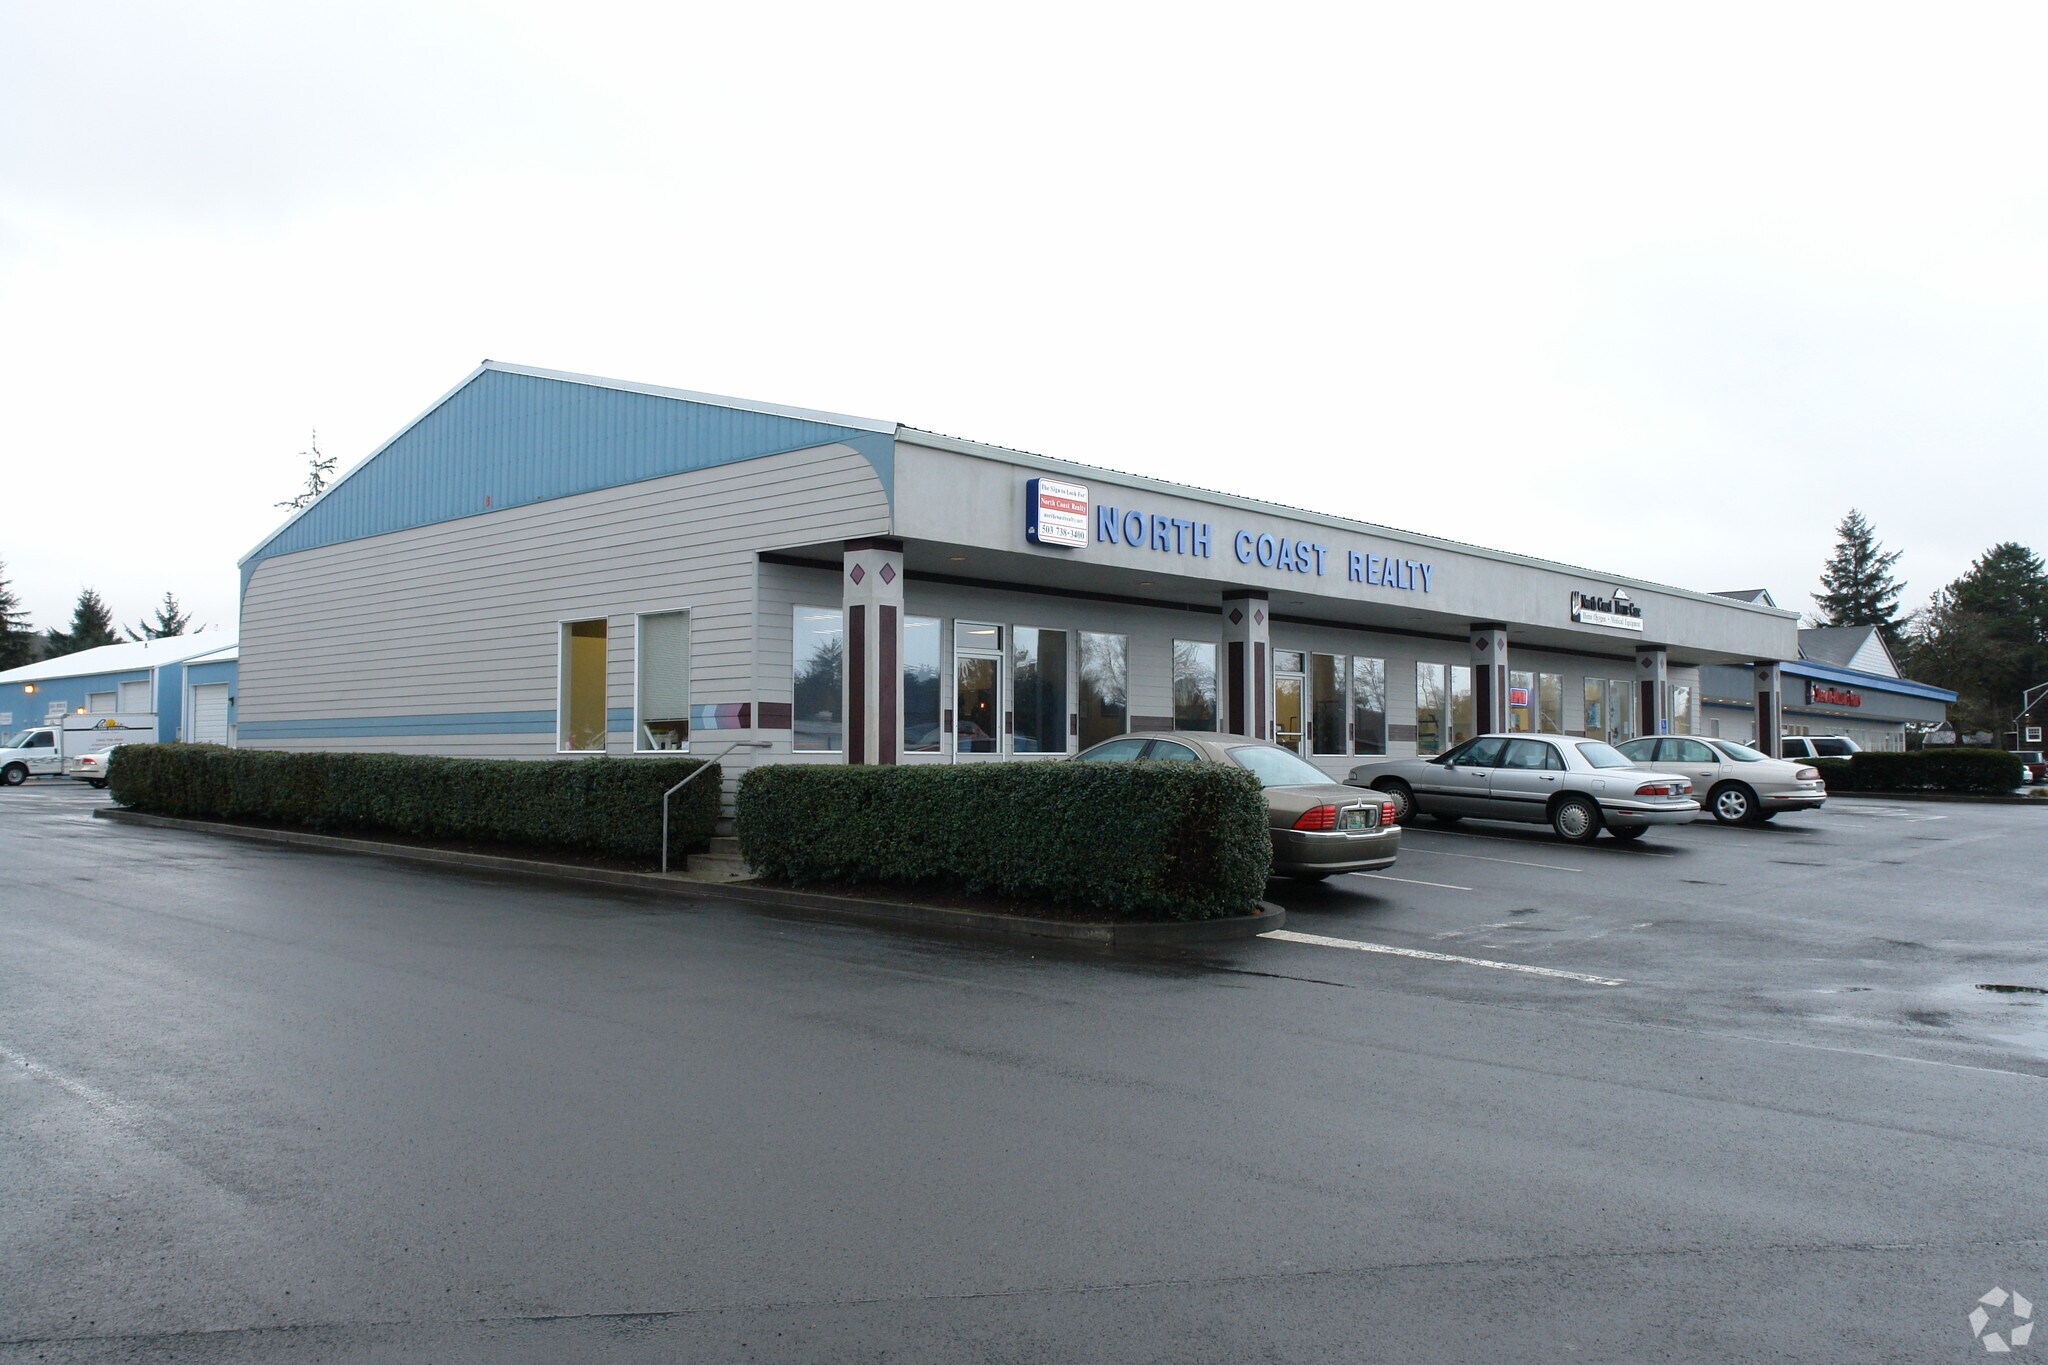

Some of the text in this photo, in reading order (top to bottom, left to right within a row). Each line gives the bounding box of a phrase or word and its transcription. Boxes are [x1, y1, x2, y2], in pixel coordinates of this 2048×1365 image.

[1041, 497, 1086, 513] North Coast Realty
[1042, 525, 1054, 535] 503
[1097, 505, 1434, 593] NORTH COAST REALTY
